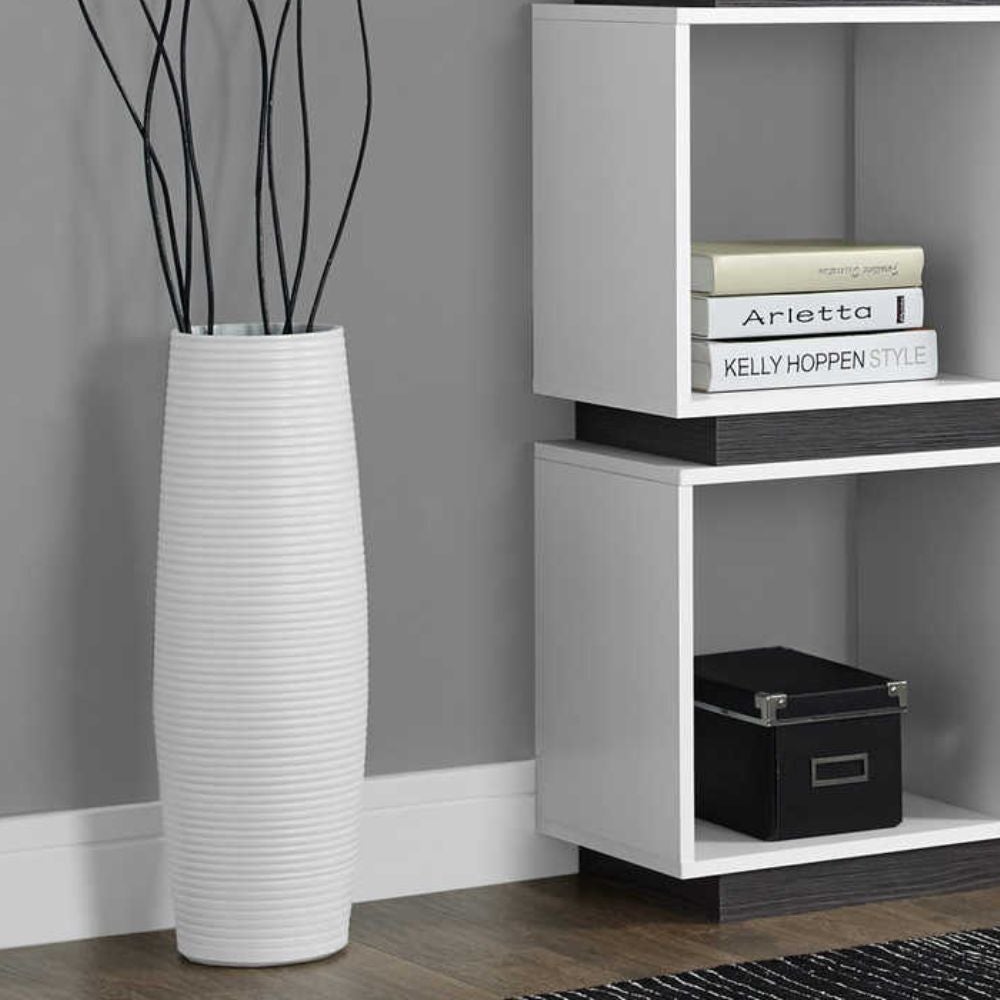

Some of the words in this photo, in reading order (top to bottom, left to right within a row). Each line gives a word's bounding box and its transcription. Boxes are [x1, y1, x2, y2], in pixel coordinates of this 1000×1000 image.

[742, 304, 872, 326] Arletta
[724, 354, 784, 377] KELLY
[786, 350, 866, 374] HOPPEN
[869, 345, 927, 369] STYLE
